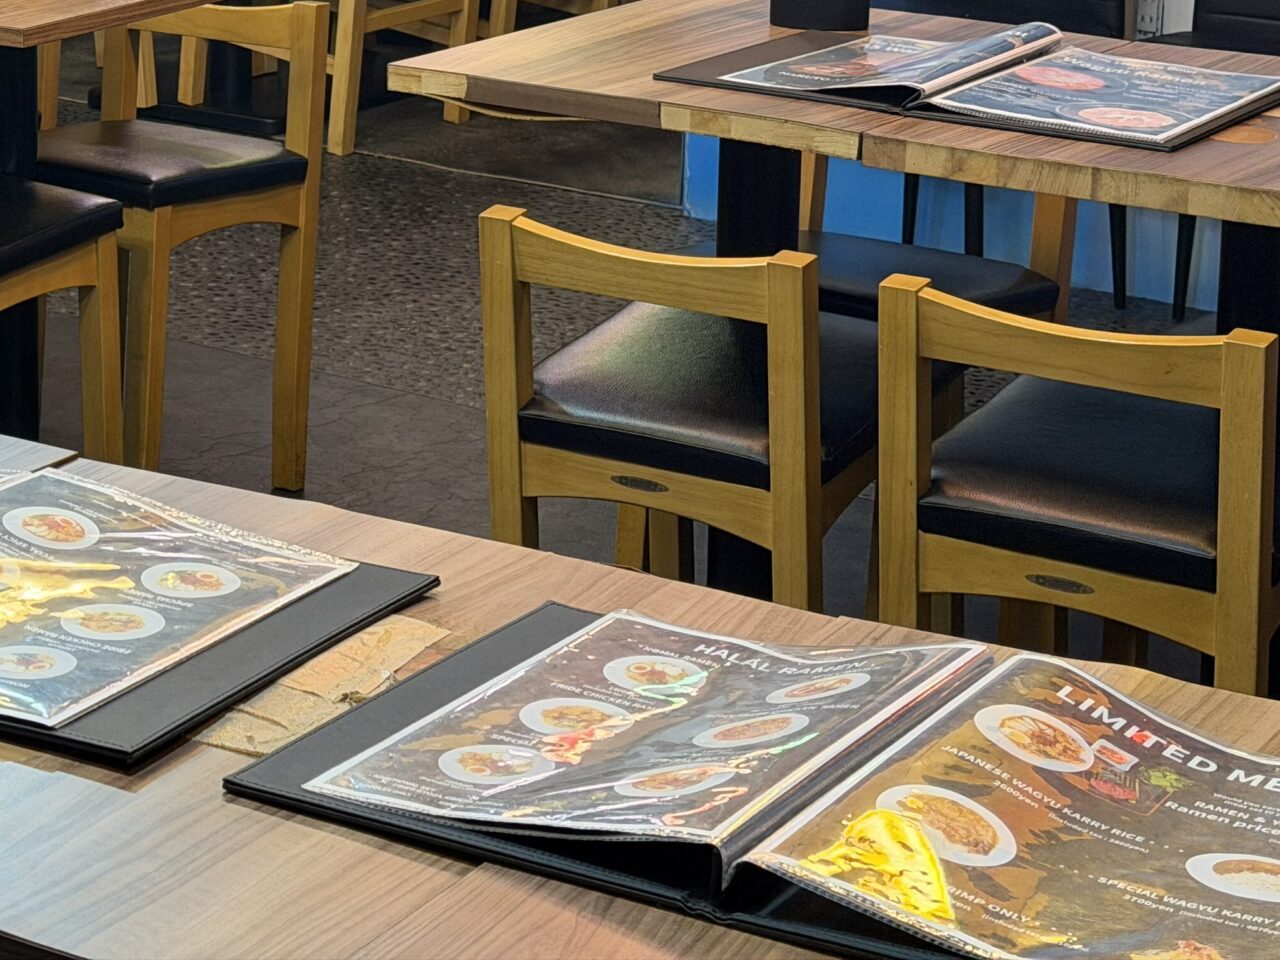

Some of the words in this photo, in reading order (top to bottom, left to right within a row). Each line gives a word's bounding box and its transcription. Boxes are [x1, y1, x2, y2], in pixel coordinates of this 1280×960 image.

[1055, 685, 1218, 773] LIMITED
[940, 744, 1011, 781] JAPANESE
[1012, 777, 1062, 810] WAGYU
[1062, 805, 1111, 832] KARRY
[1111, 827, 1146, 844] RICE
[1164, 800, 1231, 824] Ramen
[1194, 800, 1251, 820] RAMEN
[986, 901, 1033, 924] ONLY
[1097, 876, 1162, 901] SPECIAL
[1162, 894, 1220, 914] WAGYU
[1220, 908, 1275, 926] KARRY
